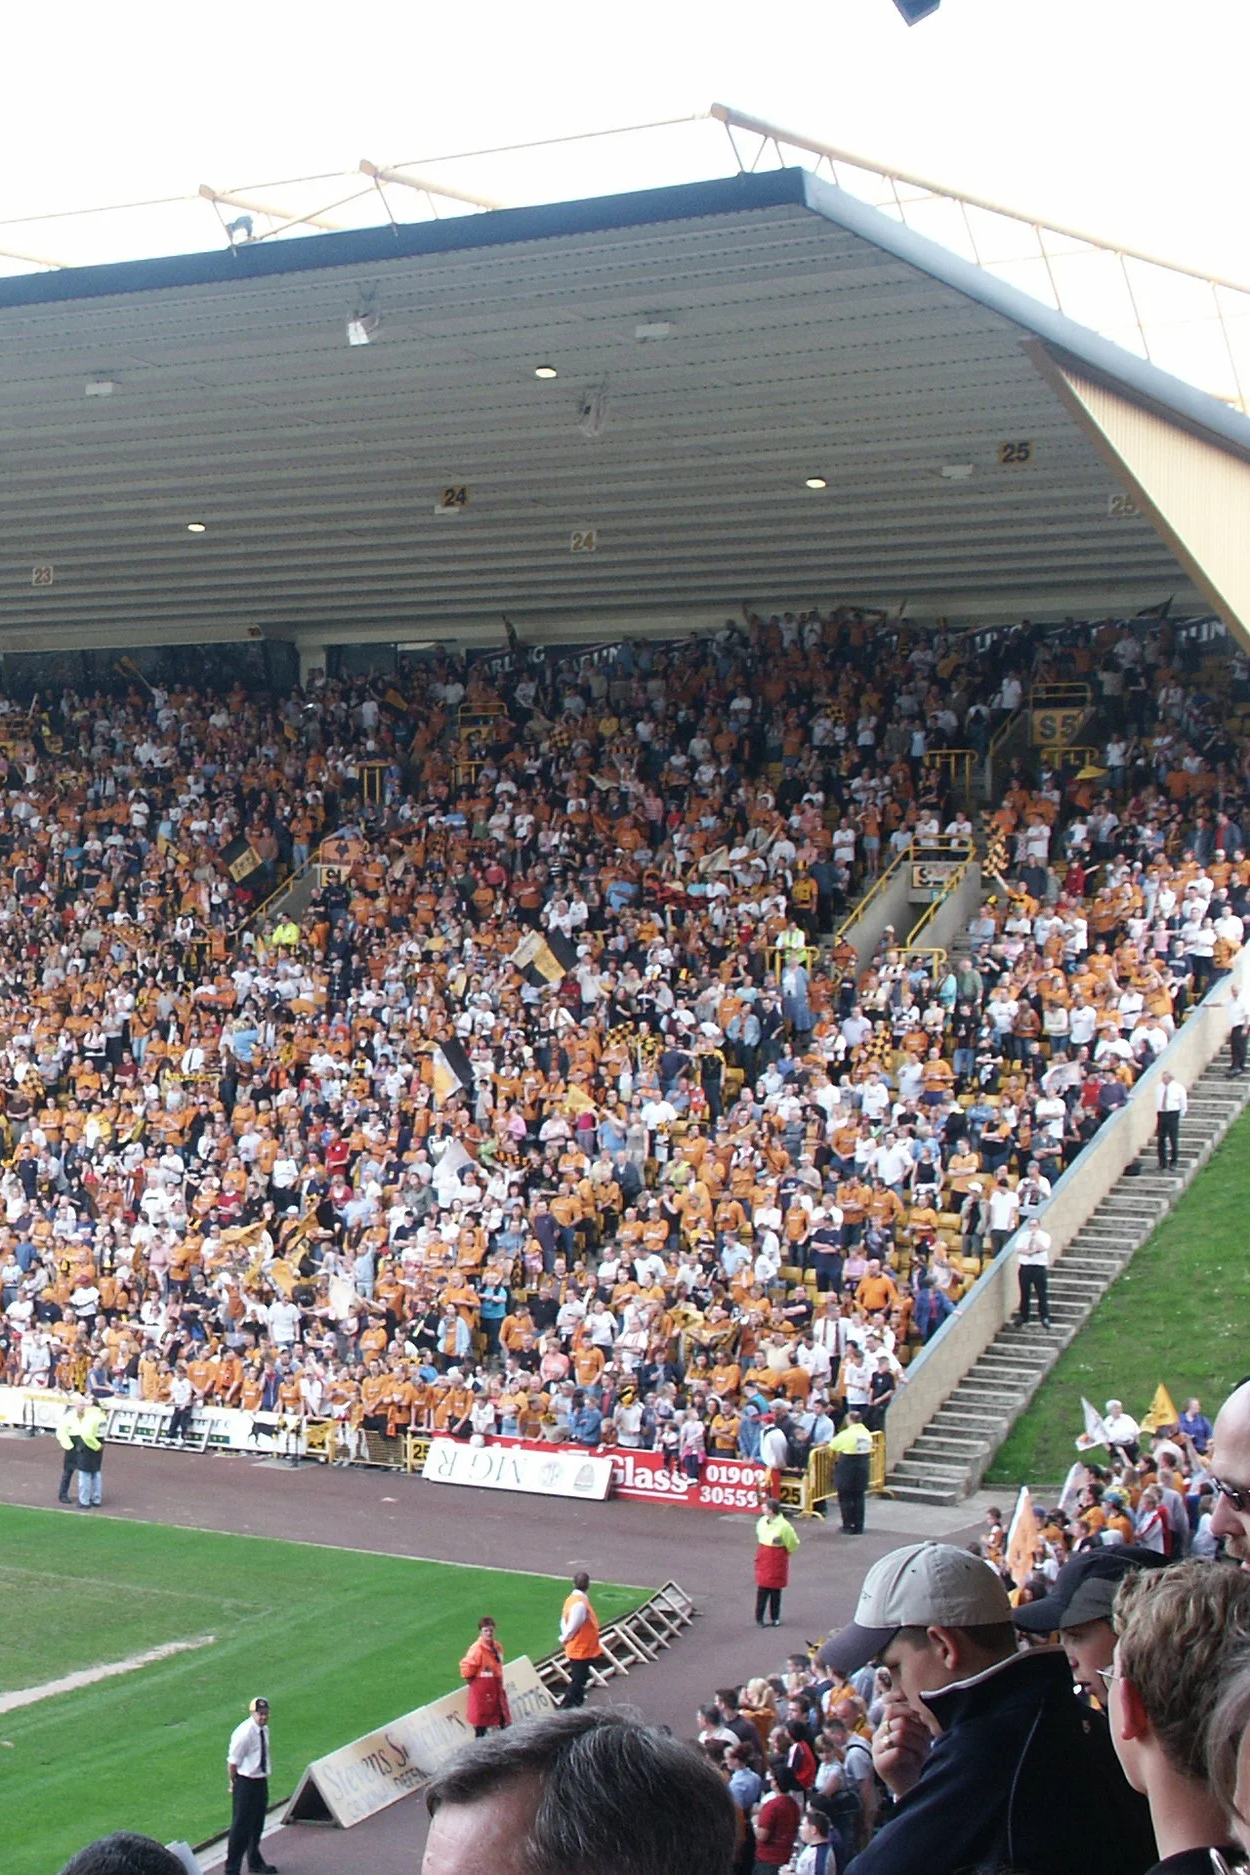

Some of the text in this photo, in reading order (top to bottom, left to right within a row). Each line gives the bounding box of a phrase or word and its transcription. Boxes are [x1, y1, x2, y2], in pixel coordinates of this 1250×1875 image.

[1002, 442, 1031, 463] 25
[443, 487, 467, 506] 24
[571, 530, 595, 551] 24
[33, 567, 52, 584] 23
[1040, 714, 1078, 740] S5
[609, 1454, 689, 1493] Glass
[699, 1485, 763, 1508] 30559
[780, 1486, 801, 1505] 25
